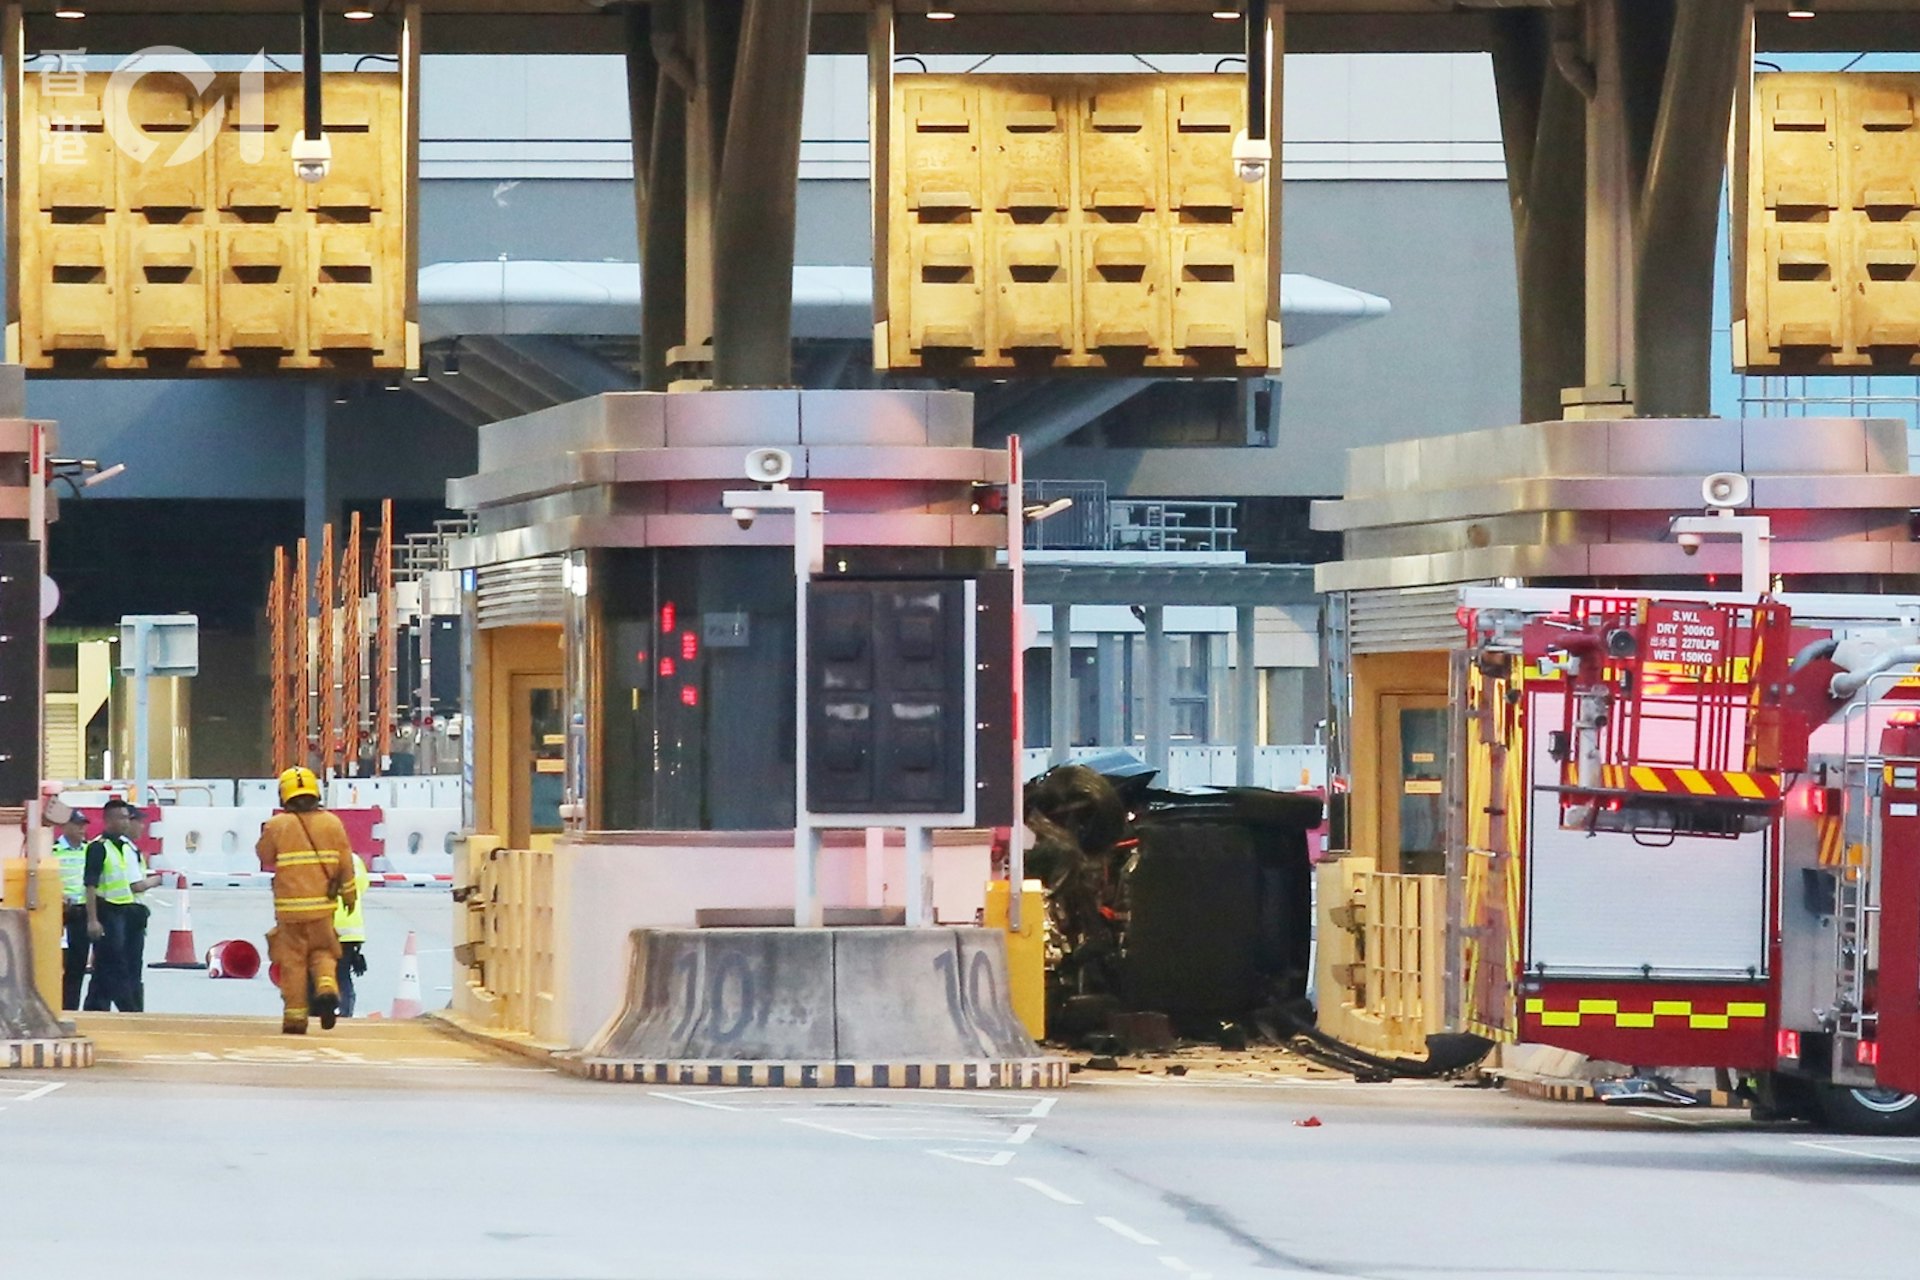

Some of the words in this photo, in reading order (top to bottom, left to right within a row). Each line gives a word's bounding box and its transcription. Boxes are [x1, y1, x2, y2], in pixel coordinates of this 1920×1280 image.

[1656, 623, 1678, 634] DRY
[1682, 625, 1715, 637] 300KG
[1649, 637, 1677, 648] 出水量
[1681, 639, 1720, 650] 2270LPM
[1653, 650, 1677, 660] WET
[1681, 652, 1713, 664] 150KG
[671, 951, 755, 1044] 10
[933, 949, 1006, 1044] 10
